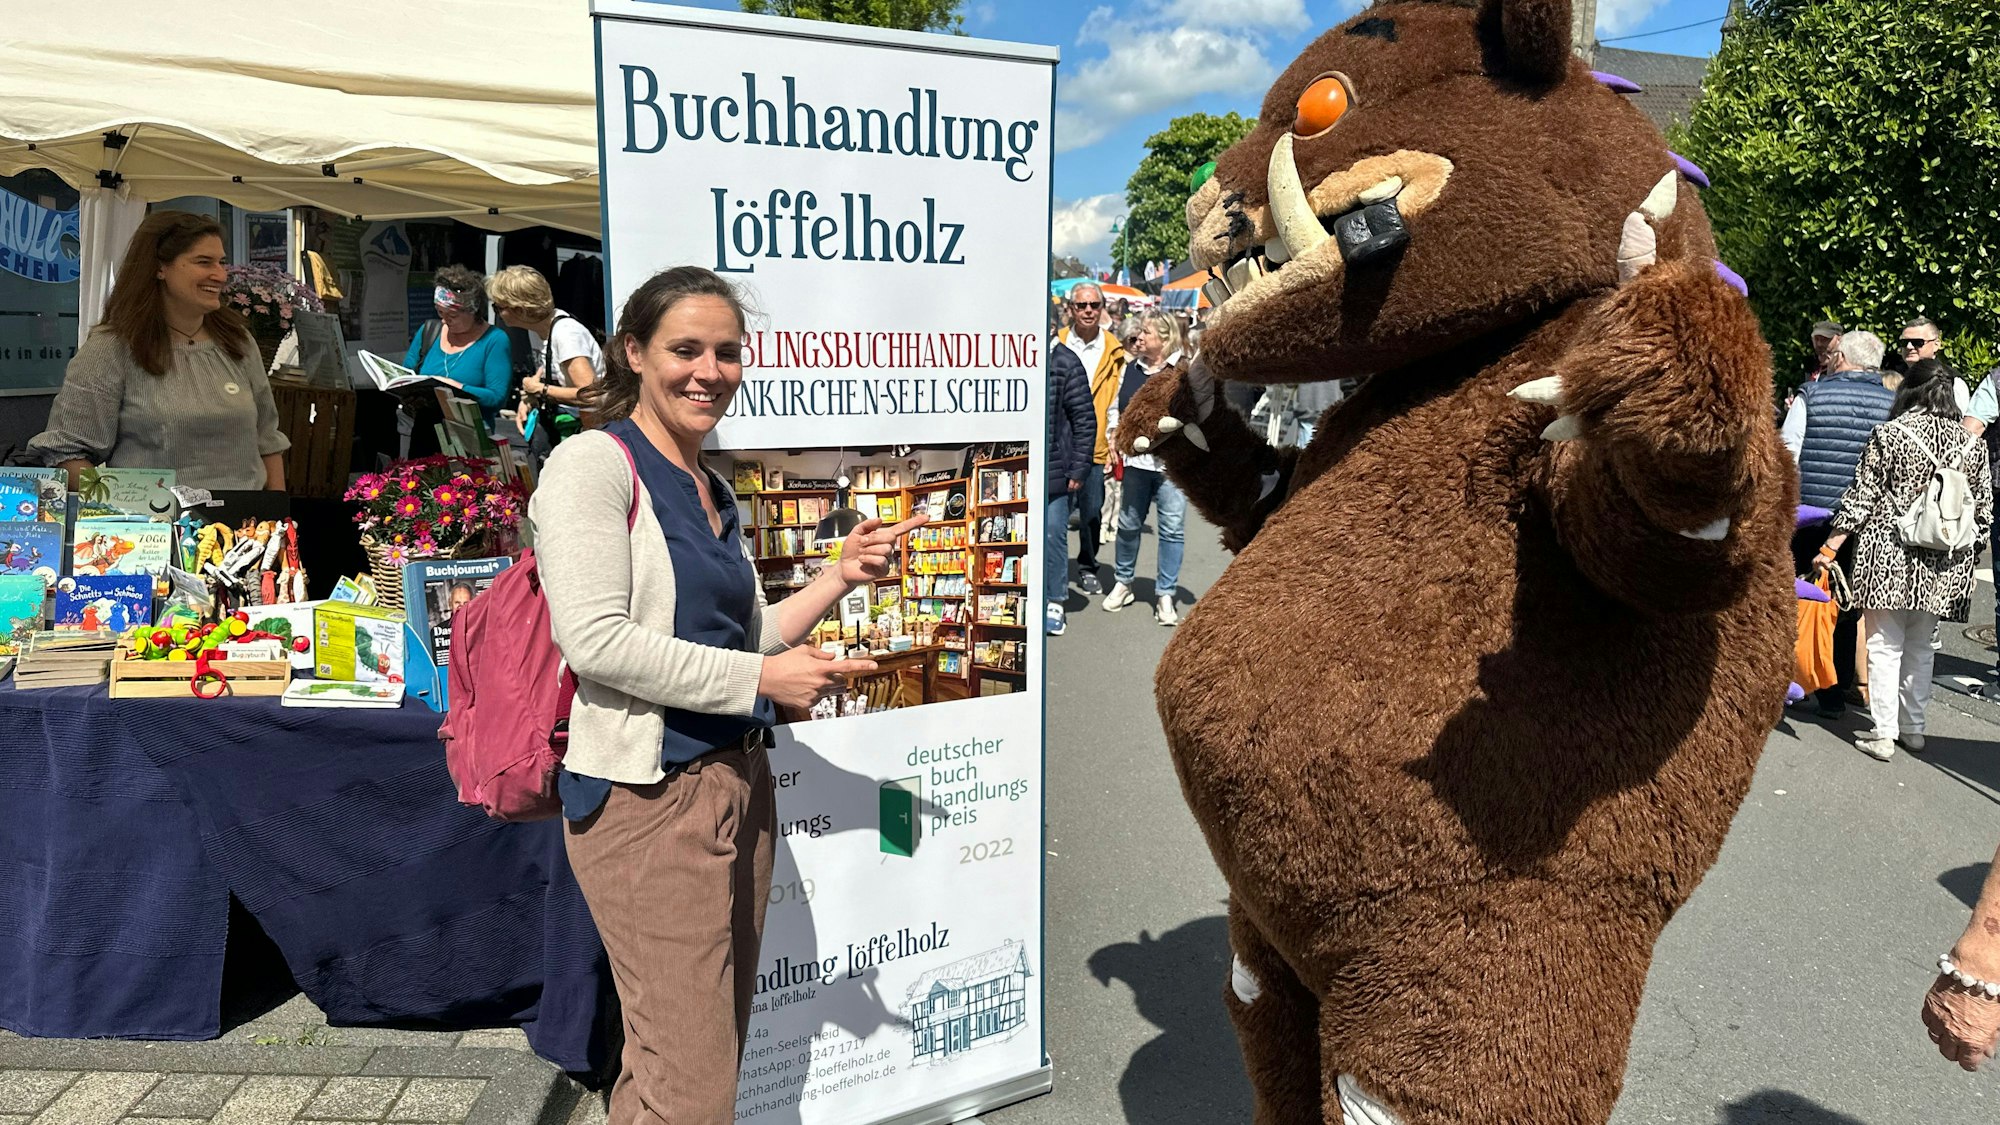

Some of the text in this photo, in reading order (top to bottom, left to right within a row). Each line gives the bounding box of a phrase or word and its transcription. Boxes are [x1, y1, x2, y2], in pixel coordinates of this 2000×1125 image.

[619, 64, 1039, 182] Buchhandlung
[710, 187, 965, 273] Löffelholz
[17, 346, 32, 360] in
[40, 346, 62, 360] die
[425, 563, 493, 577] Buchjournal
[906, 737, 1004, 766] deutscher
[931, 761, 977, 786] buch
[931, 778, 1029, 809] handlungs
[781, 814, 832, 839] ungs
[931, 806, 977, 836] preis
[959, 837, 1014, 864] 2022
[754, 921, 950, 995] ndlung Löffelholz
[750, 987, 816, 1014] ina Löffelholz
[744, 1026, 840, 1062] chen-Seelscheid
[754, 1028, 769, 1040] 4a
[737, 1037, 866, 1082] hatsApp: 02247 1717
